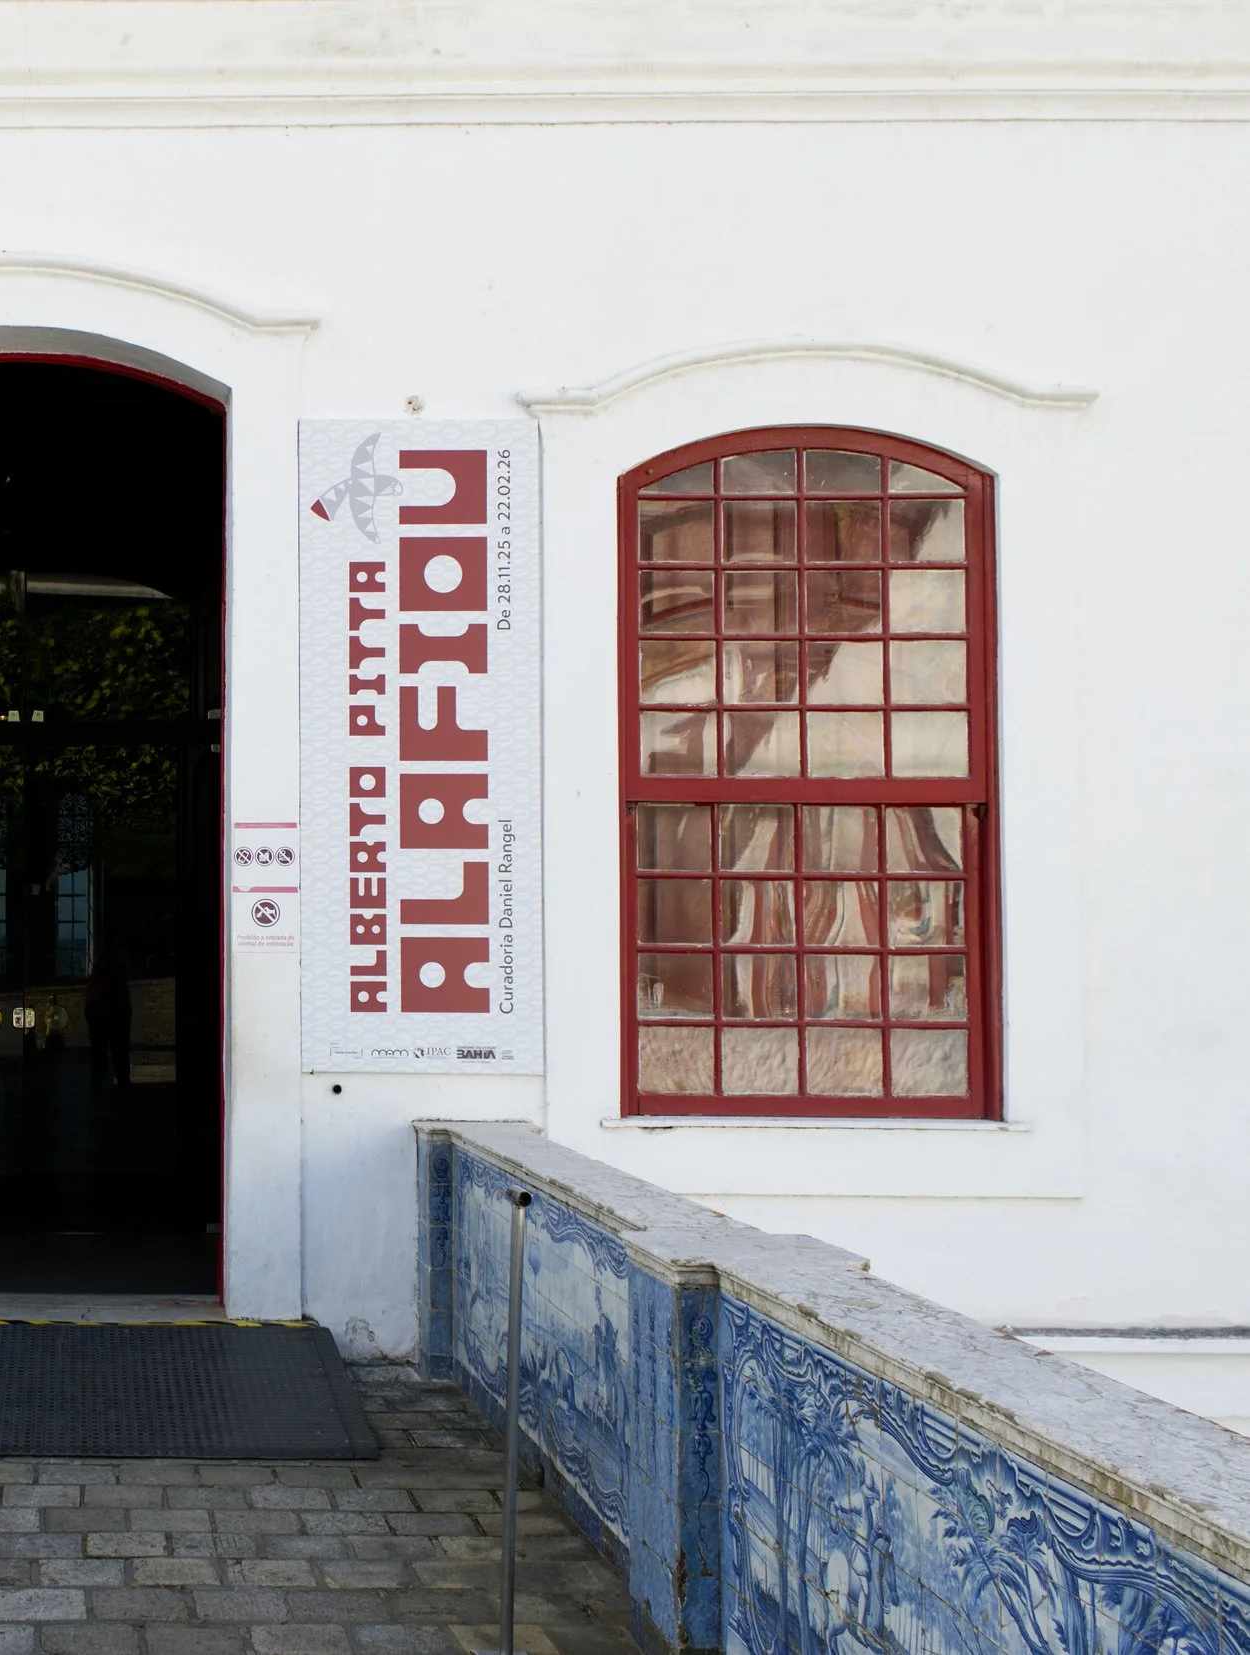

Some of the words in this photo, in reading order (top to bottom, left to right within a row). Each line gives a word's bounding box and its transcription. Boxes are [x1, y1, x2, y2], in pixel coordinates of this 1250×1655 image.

[497, 450, 511, 520] 22.02.26
[501, 527, 511, 535] a
[498, 541, 511, 603] 28.11.25
[349, 563, 386, 736] PITTA
[497, 610, 511, 630] De
[400, 450, 489, 1012] ALAFIOU
[498, 820, 516, 872] Rangel
[349, 768, 386, 1012] ALBERTO
[498, 879, 513, 928] Daniel
[499, 935, 514, 1014] Curadoria
[427, 1047, 451, 1056] IPAC
